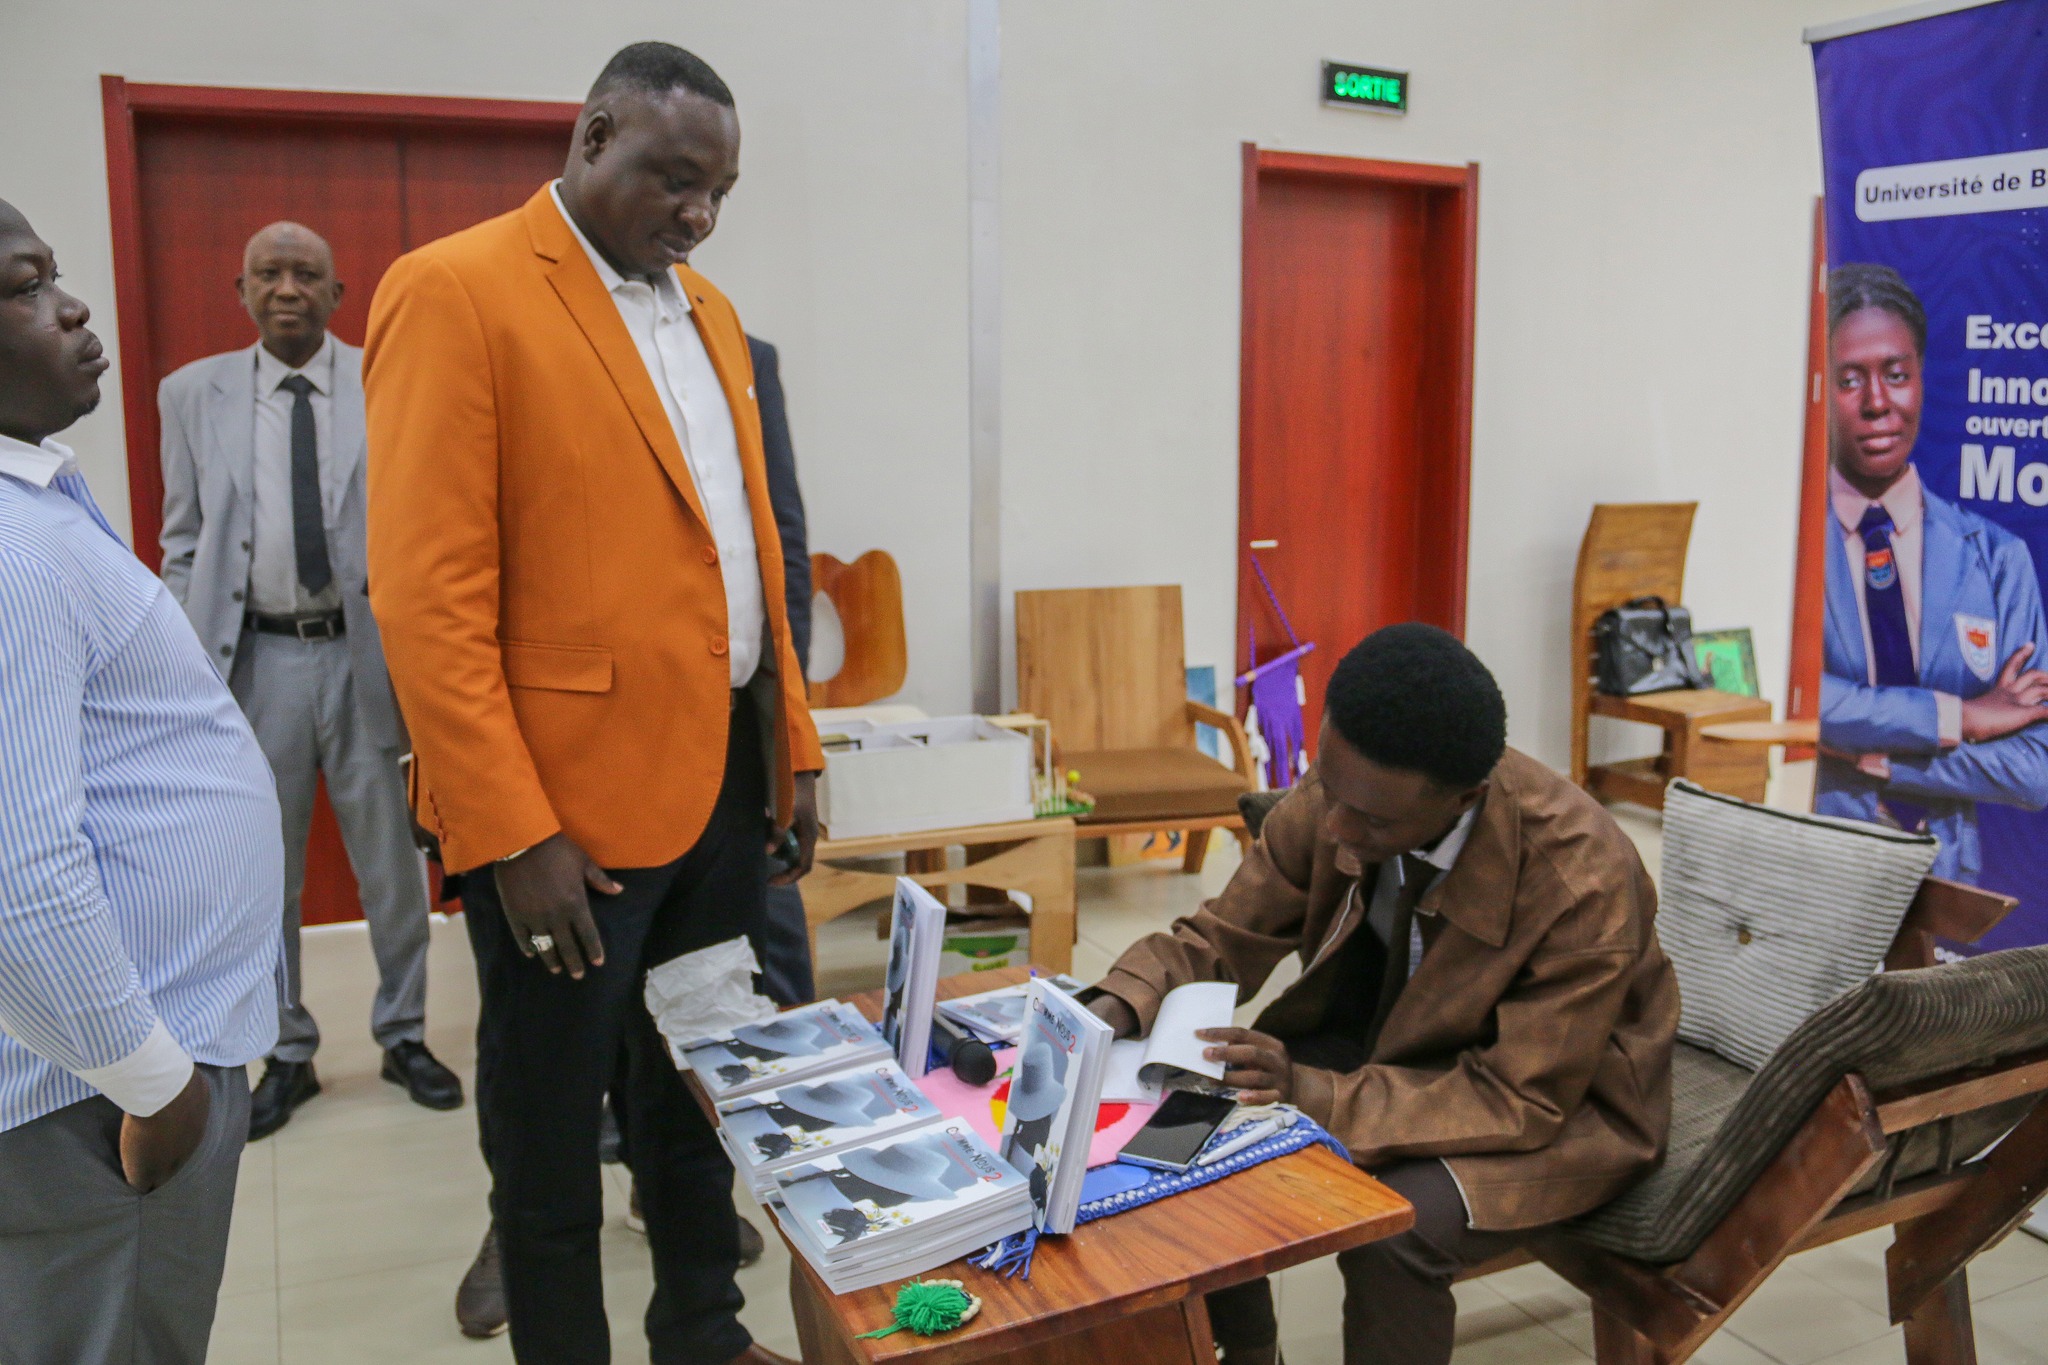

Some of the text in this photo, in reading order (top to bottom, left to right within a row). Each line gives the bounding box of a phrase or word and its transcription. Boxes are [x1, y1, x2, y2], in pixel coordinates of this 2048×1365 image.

[1865, 174, 1983, 203] Université
[1993, 173, 2021, 192] de
[1967, 368, 2048, 406] Inno
[1959, 442, 2048, 507] Mo
[1067, 1033, 1077, 1055] 2
[981, 1171, 1003, 1183] 2
